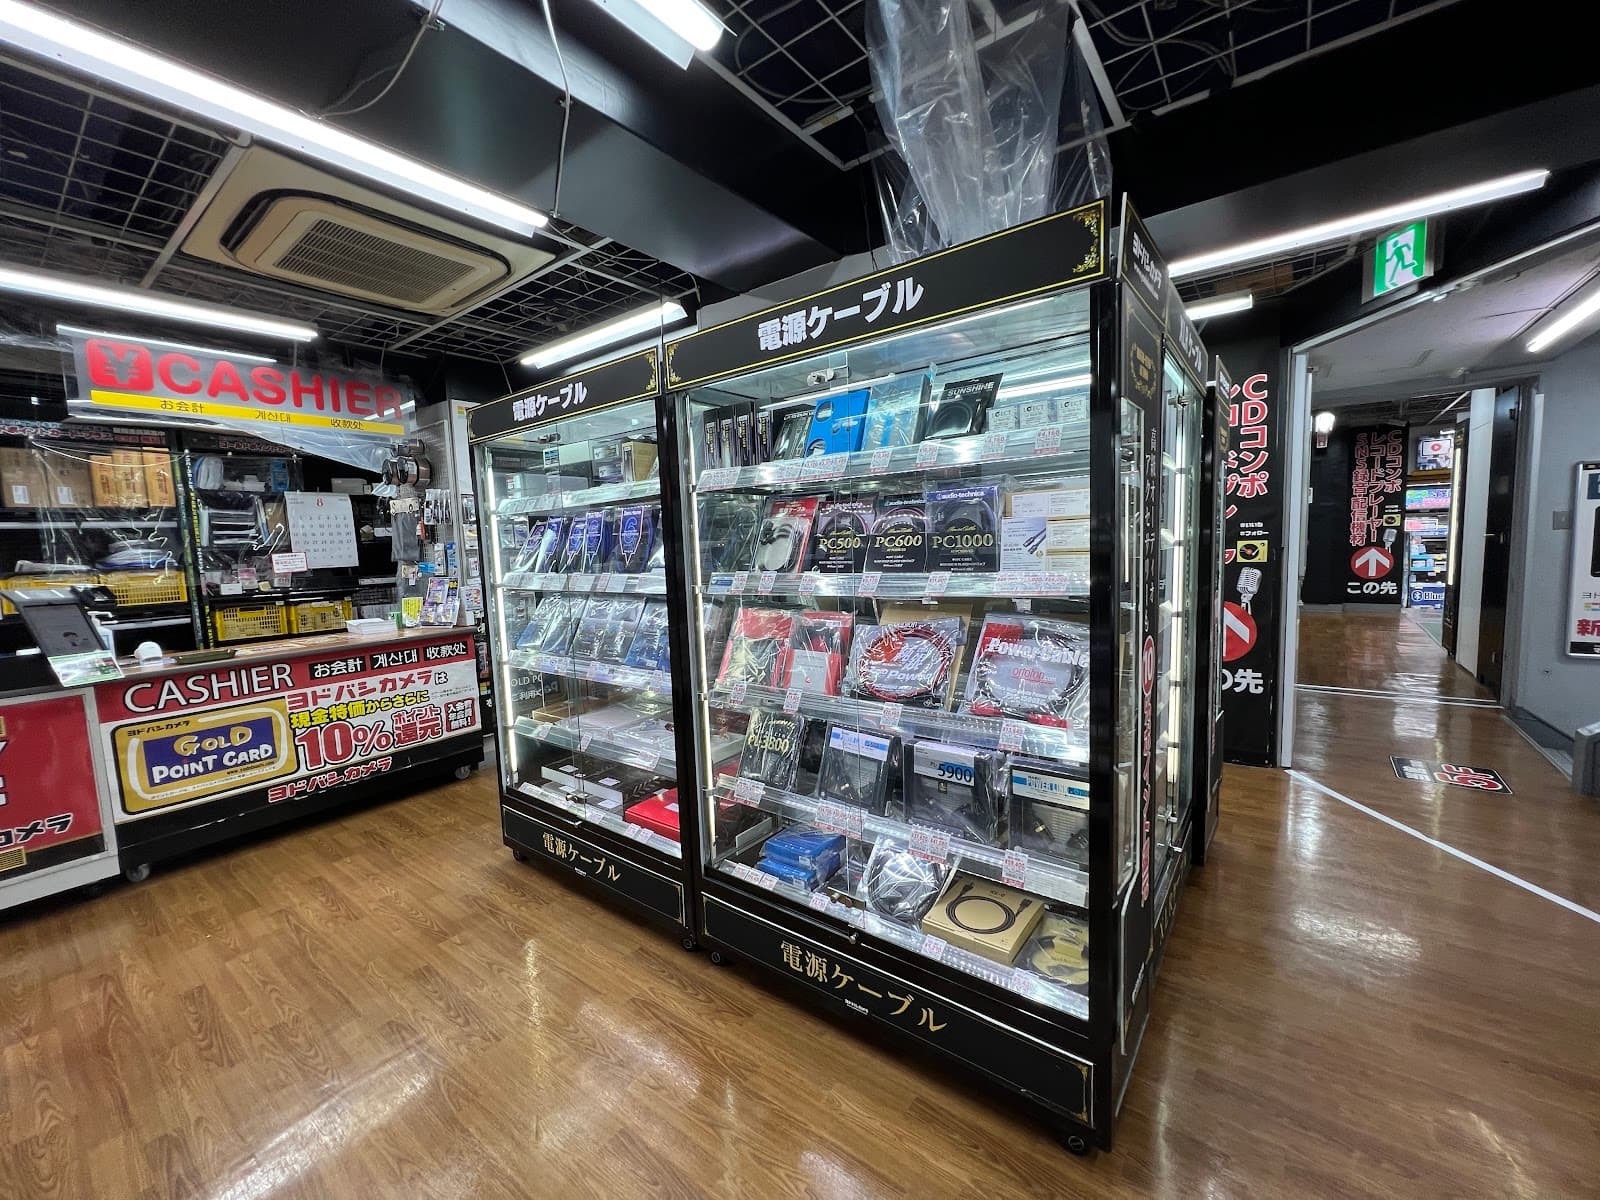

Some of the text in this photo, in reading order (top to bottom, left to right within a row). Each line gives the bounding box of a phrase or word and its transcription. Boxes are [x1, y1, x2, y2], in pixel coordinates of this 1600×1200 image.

[758, 277, 925, 351] 電源ケーブル
[157, 352, 403, 418] CASHIER
[947, 381, 995, 397] SUNSHINE
[159, 398, 205, 414] お会計
[512, 380, 588, 422] 電源ケーブル
[255, 409, 292, 423] 계산대
[330, 418, 365, 431] 收款处
[1237, 373, 1269, 498] CDコンポ
[941, 490, 985, 500] audio-technica
[1368, 431, 1386, 543] レコードプレーヤー
[818, 536, 861, 550] PC500
[873, 534, 923, 548] PC600
[931, 533, 994, 549] PC1000
[1347, 581, 1398, 595] この先
[372, 648, 418, 668] 계산대
[426, 642, 466, 660] 收款处
[313, 659, 363, 678] お会計
[124, 663, 294, 713] CASHIER
[289, 690, 430, 729] 現金特価からさらに
[392, 704, 441, 726] ポイント
[127, 719, 191, 738] ヨドバシカメラ
[394, 717, 441, 748] 還元
[173, 726, 253, 756] GOLD
[296, 720, 393, 771] 10%
[222, 743, 273, 766] CARD
[267, 756, 392, 804] ヨドバシカメラ
[937, 763, 973, 783] 5900
[542, 831, 621, 883] 電源ケーブル
[780, 940, 948, 1032] 電源ケーブル
